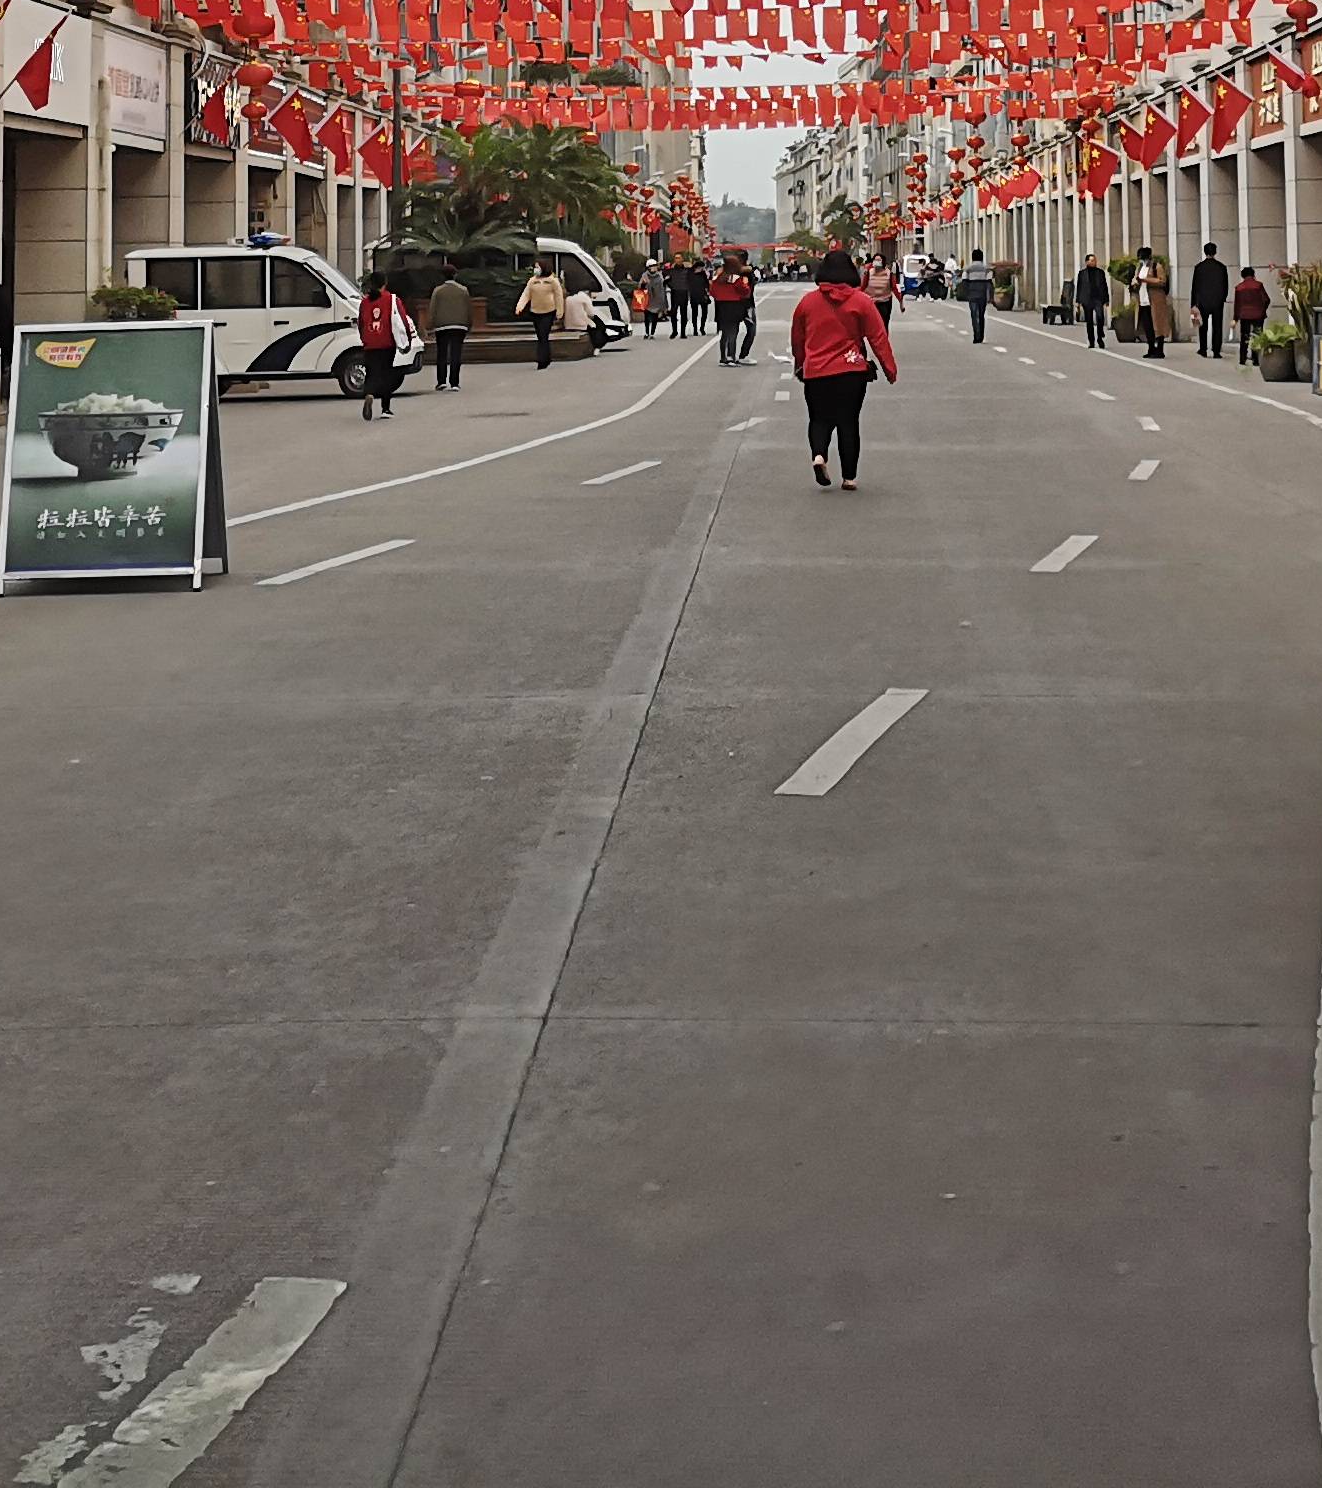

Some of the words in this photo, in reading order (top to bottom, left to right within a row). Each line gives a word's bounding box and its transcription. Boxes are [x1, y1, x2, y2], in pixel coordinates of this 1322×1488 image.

[36, 504, 167, 530] 粒粒皆辛苦
